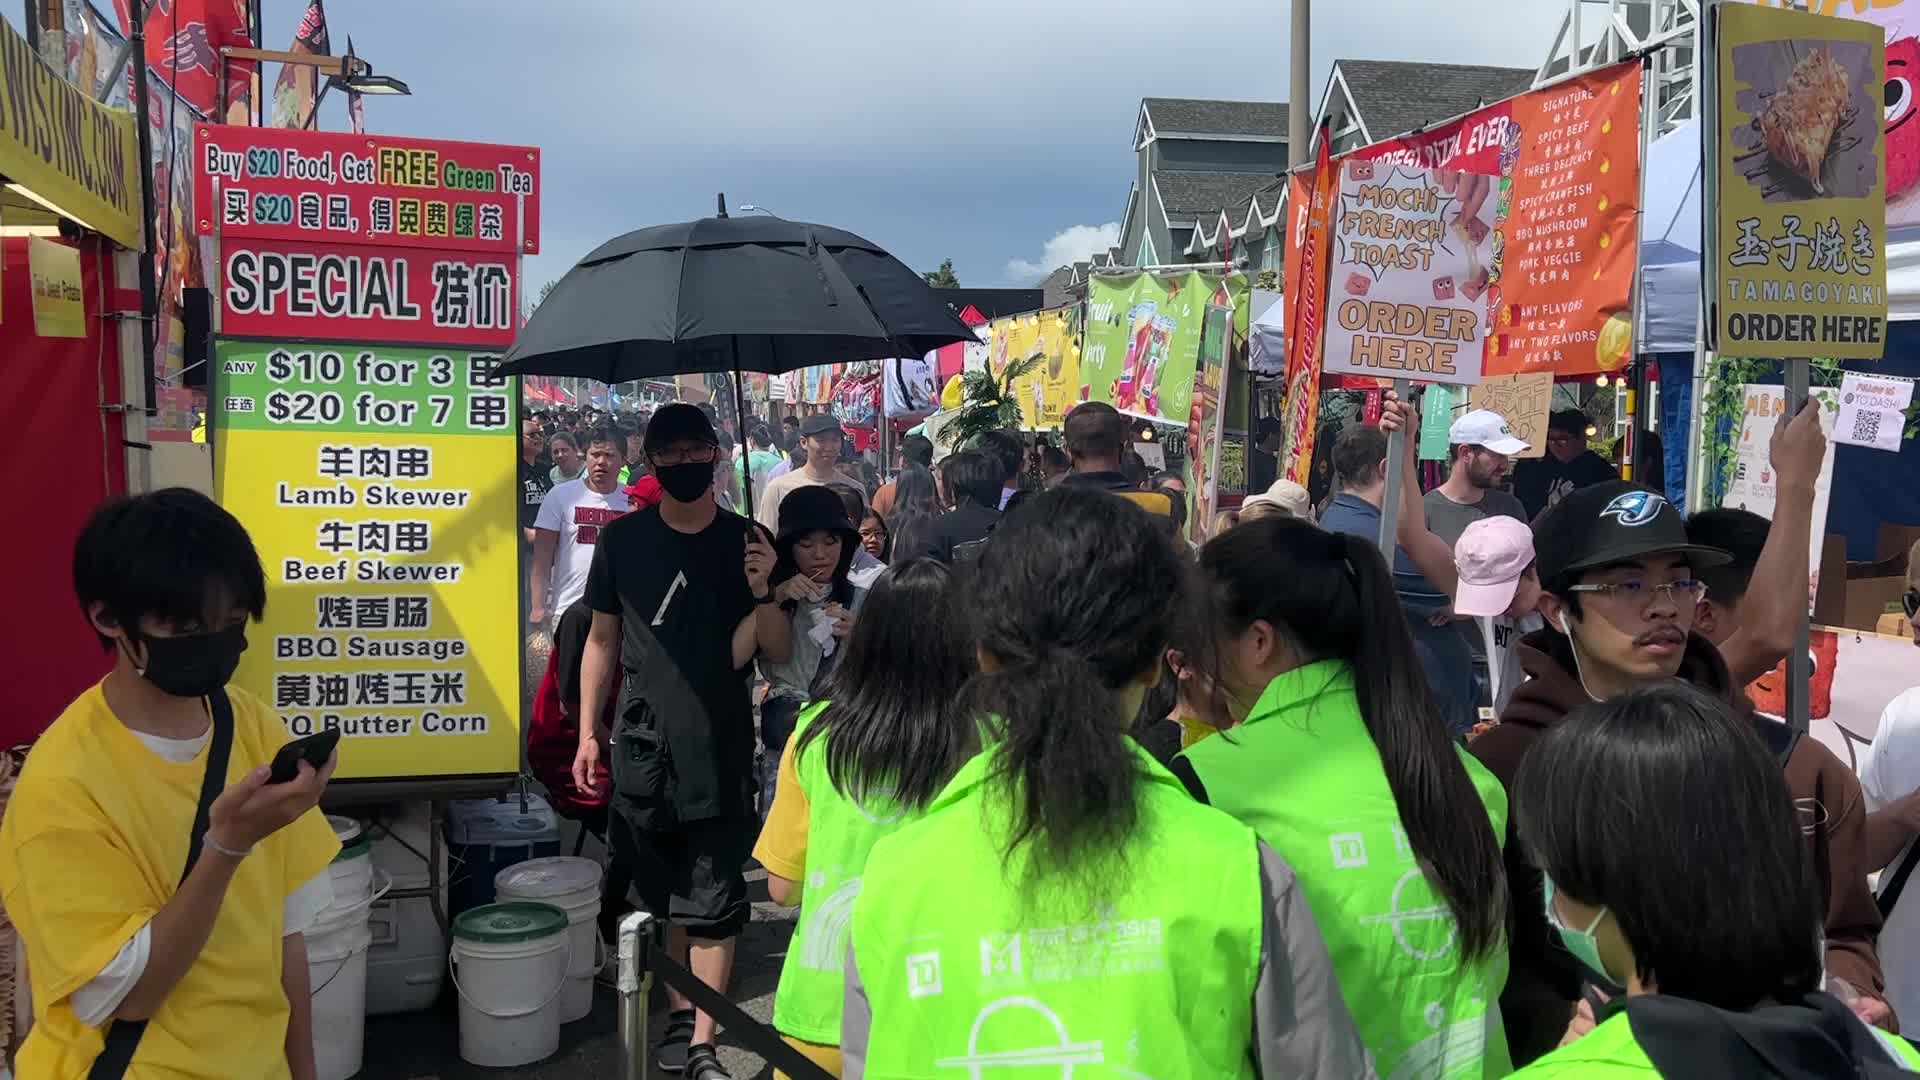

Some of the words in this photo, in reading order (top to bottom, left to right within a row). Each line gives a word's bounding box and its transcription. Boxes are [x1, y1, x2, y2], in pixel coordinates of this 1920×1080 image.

[1543, 90, 1594, 112] SIGNATURE
[1466, 116, 1509, 155] EVER
[1538, 127, 1563, 144] SPICY
[1567, 120, 1590, 137] BEEF
[207, 145, 243, 179] Buy
[248, 148, 280, 176] $20
[284, 149, 337, 183] Food,
[342, 154, 374, 182] Get
[379, 149, 438, 187] FREE
[443, 161, 495, 192] Green
[500, 164, 532, 194] Tea
[1524, 162, 1553, 177] THREE
[1519, 194, 1543, 210] SPICY
[1546, 183, 1593, 203] CRAWFISH
[1342, 210, 1446, 244] FRENCH
[1536, 217, 1588, 236] MUSHROOM
[1350, 242, 1434, 271] TOAST
[1544, 251, 1582, 267] VEGGIE
[1728, 215, 1875, 276] 玉子焼き
[229, 250, 420, 320] SPECIAL
[432, 260, 511, 329] 特价
[1727, 279, 1883, 305] TAMAGOYAKI
[1338, 299, 1478, 342] ORDER
[1521, 306, 1538, 318] ANY
[1532, 336, 1549, 349] TWO
[1551, 330, 1597, 347] FLAVORS
[1727, 312, 1816, 342] ORDER
[1822, 314, 1883, 344] HERE
[223, 362, 256, 374] ANY
[268, 351, 341, 381] $10
[356, 354, 415, 383] for
[430, 358, 452, 385] 3
[469, 356, 506, 388] 串
[1351, 335, 1458, 375] HERE
[224, 397, 254, 412] 任选
[268, 392, 341, 421] $20
[356, 395, 415, 423] for
[431, 398, 451, 424] 7
[469, 396, 506, 427] 串
[1744, 393, 1785, 417] MEN
[320, 447, 429, 477] 羊肉串
[279, 484, 355, 506] Lamb
[366, 486, 468, 507] Skewer
[319, 521, 428, 552] 牛肉串
[285, 560, 347, 581] Beef
[357, 562, 460, 581] Skewer
[318, 596, 428, 629] 烤香肠
[276, 637, 337, 658] BBQ
[348, 637, 465, 660] Sausage
[276, 672, 464, 707] 黄油烤玉米
[324, 715, 412, 735] Butter
[422, 712, 486, 732] Corn
